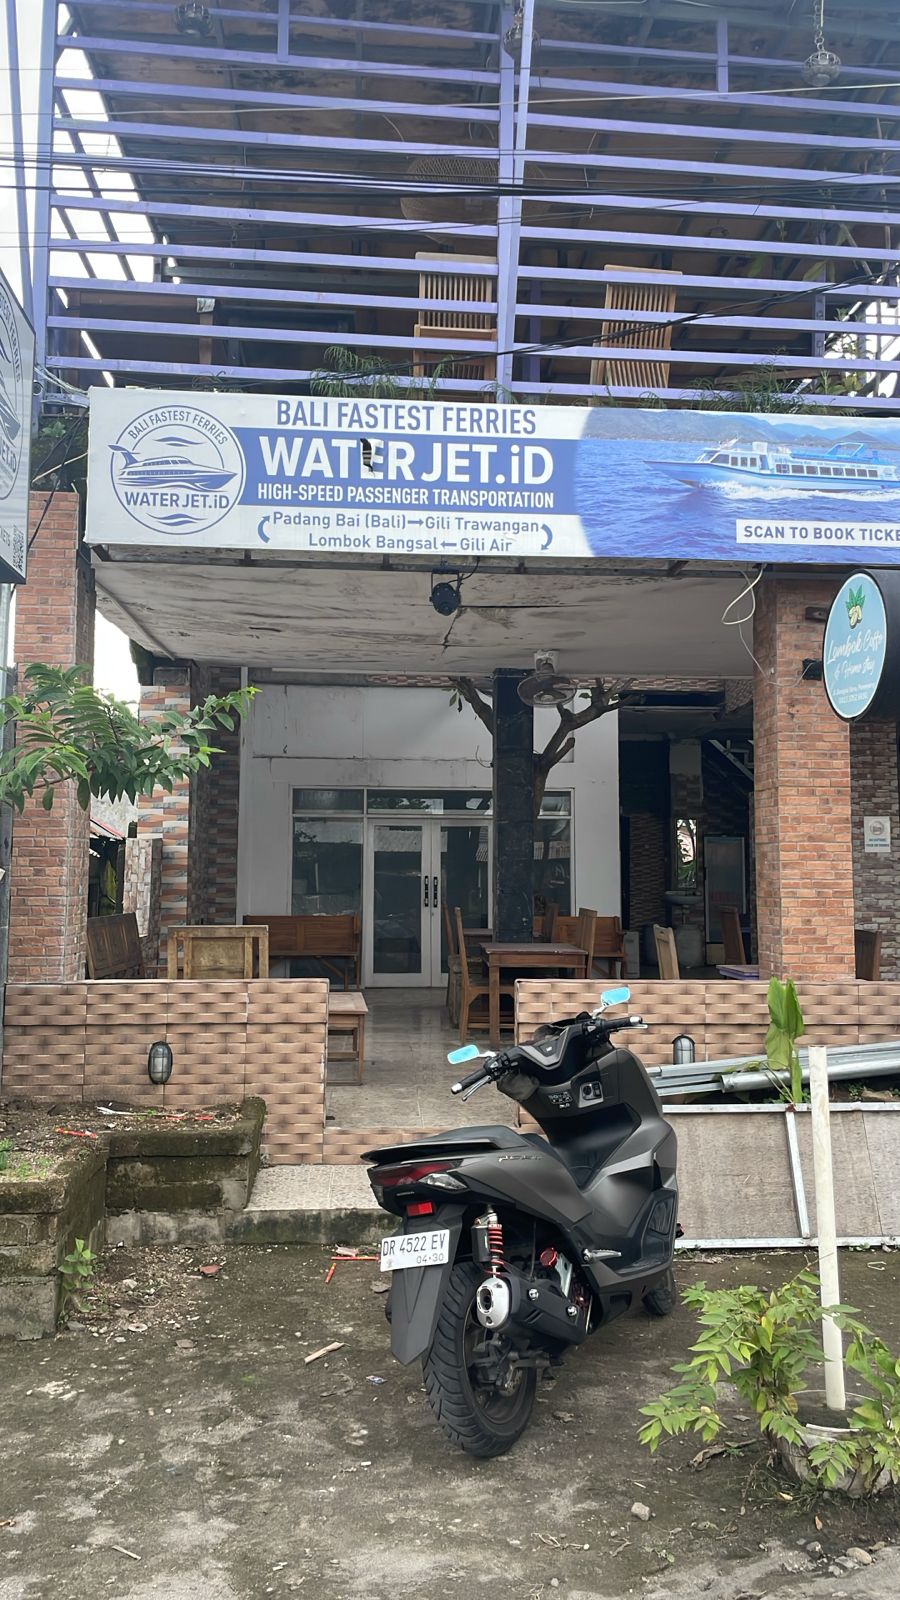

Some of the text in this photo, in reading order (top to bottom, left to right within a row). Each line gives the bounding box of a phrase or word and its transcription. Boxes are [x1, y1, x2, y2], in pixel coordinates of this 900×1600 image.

[128, 410, 228, 445] BALI FASTEST FERRIES
[276, 400, 536, 434] BALI FASTEST FERRIES
[258, 482, 554, 509] HIGH-SPEED PASSENGER TRANSPORTATION
[273, 511, 540, 535] Padang Bai (Bali) Gili Trawangan
[743, 525, 785, 539] SCAN
[789, 526, 808, 539] TO
[813, 527, 855, 540] BOOK
[309, 532, 512, 553] Lombok Bangsal Gili Air
[382, 1232, 446, 1257] DR 4522 EV
